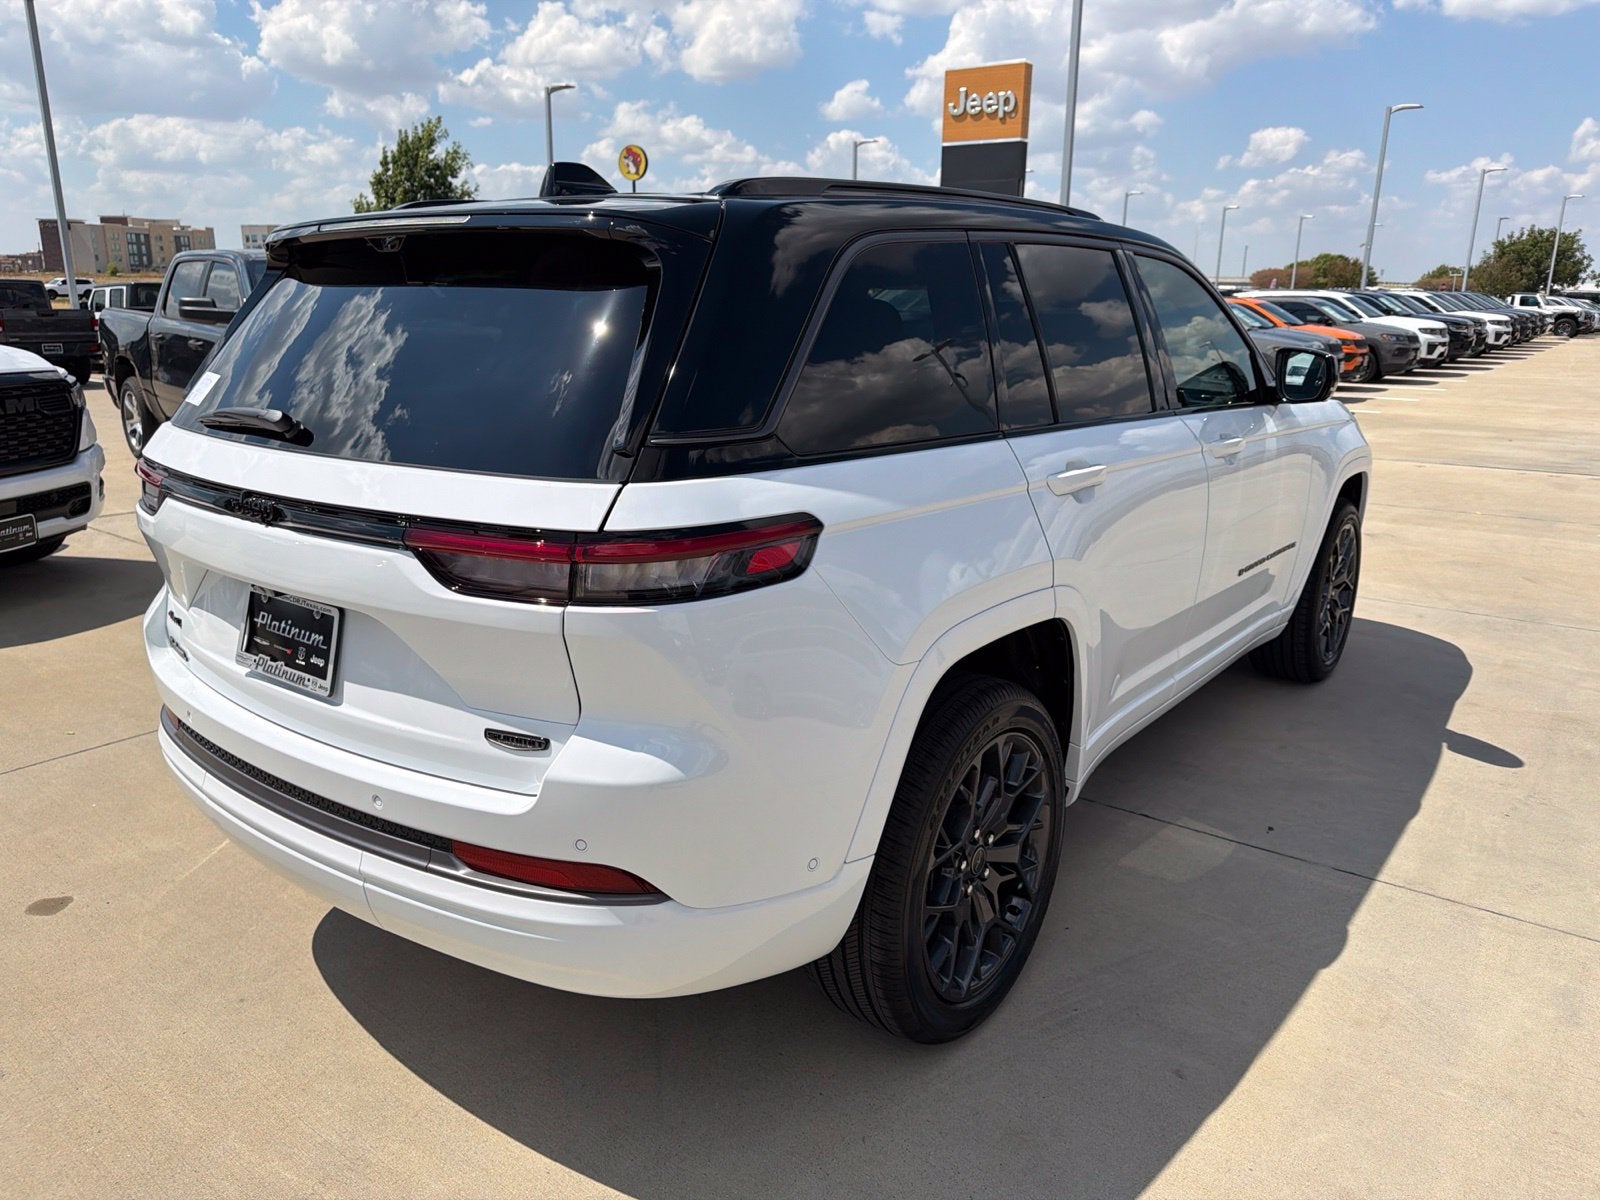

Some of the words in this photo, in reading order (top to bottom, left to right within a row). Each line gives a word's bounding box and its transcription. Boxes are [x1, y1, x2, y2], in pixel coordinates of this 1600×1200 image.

[947, 86, 1016, 118] Jeep
[253, 611, 328, 649] Platinum
[255, 656, 310, 688] Platinum
[310, 654, 326, 668] Jeep
